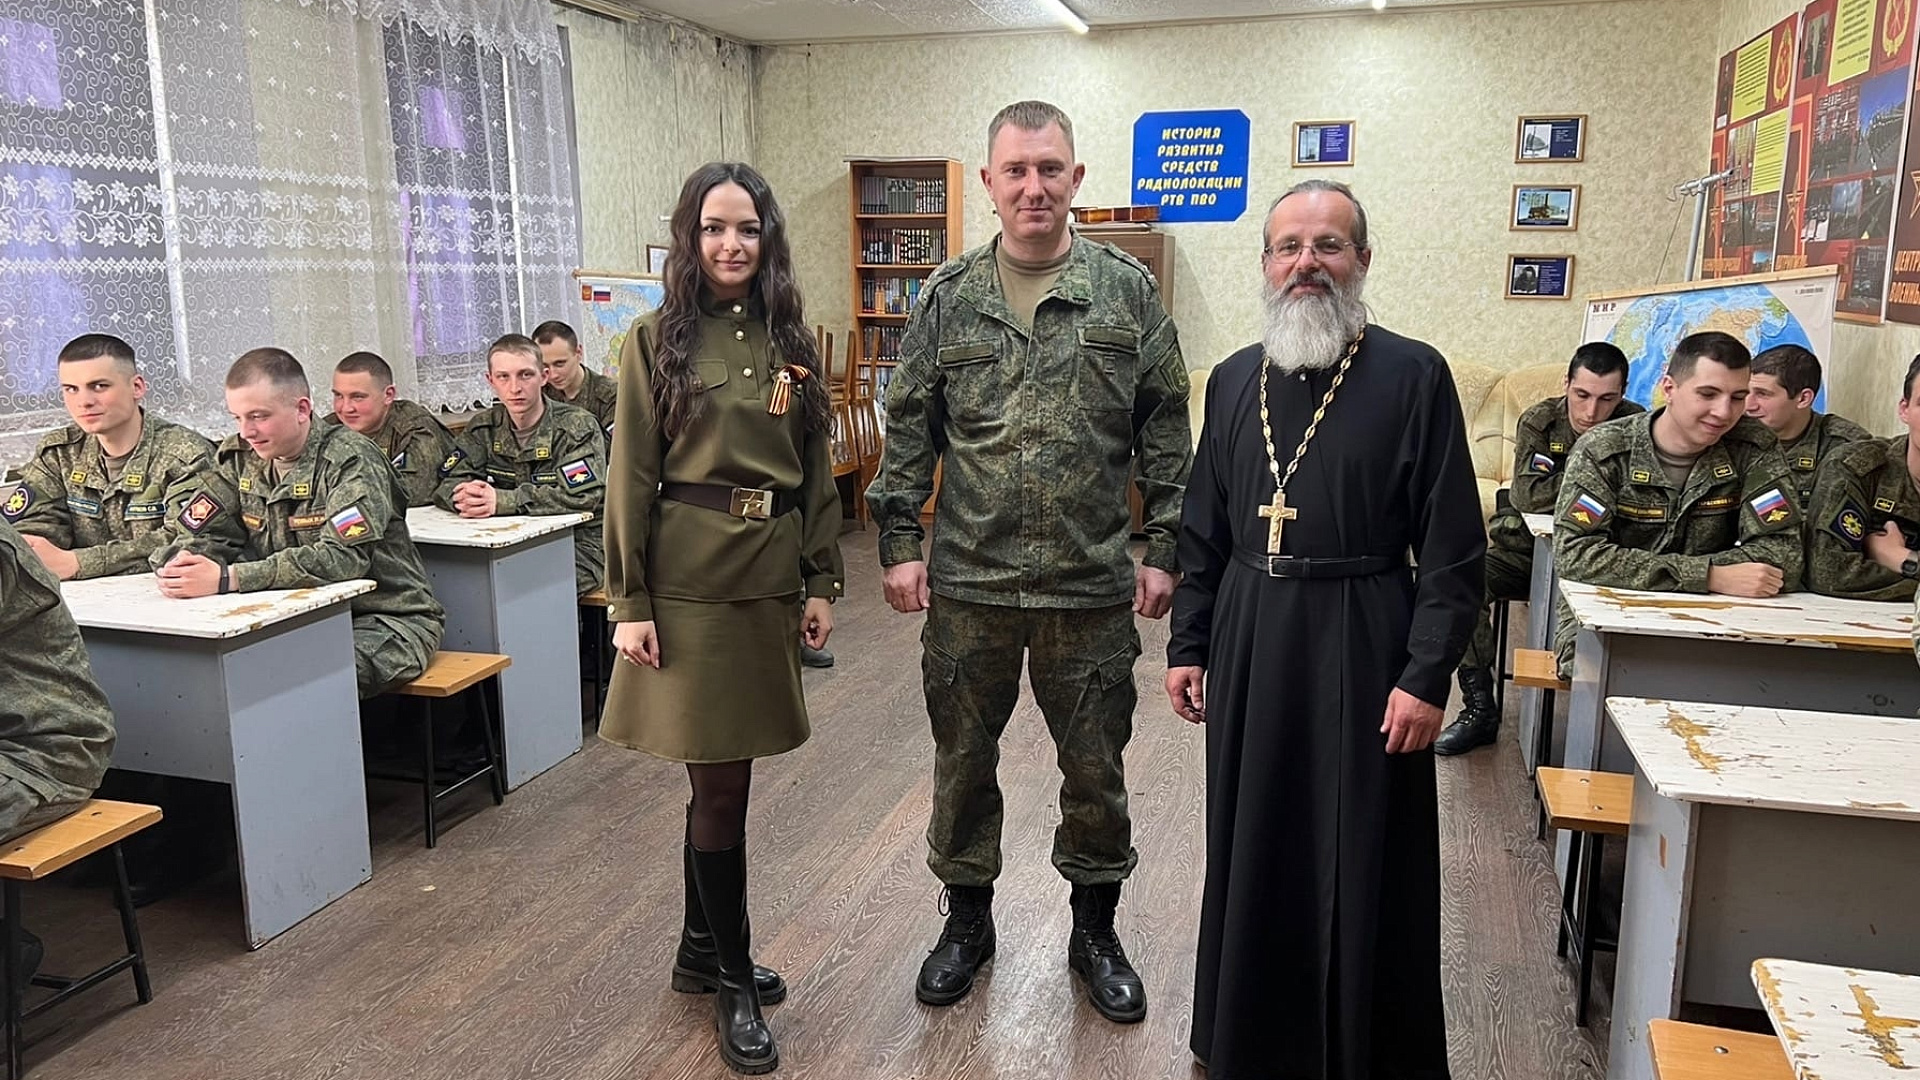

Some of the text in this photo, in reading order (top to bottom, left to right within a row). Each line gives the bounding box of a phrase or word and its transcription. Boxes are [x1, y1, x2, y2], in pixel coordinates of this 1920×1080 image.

[1162, 127, 1221, 140] ИСТОРИЯ
[1157, 144, 1224, 157] РАЗВИТИЯ
[1161, 160, 1219, 174] СРЕДСТВ
[1137, 177, 1242, 191] РАДИОЛОКАЦИИ
[1161, 193, 1217, 206] РТВ ПВО
